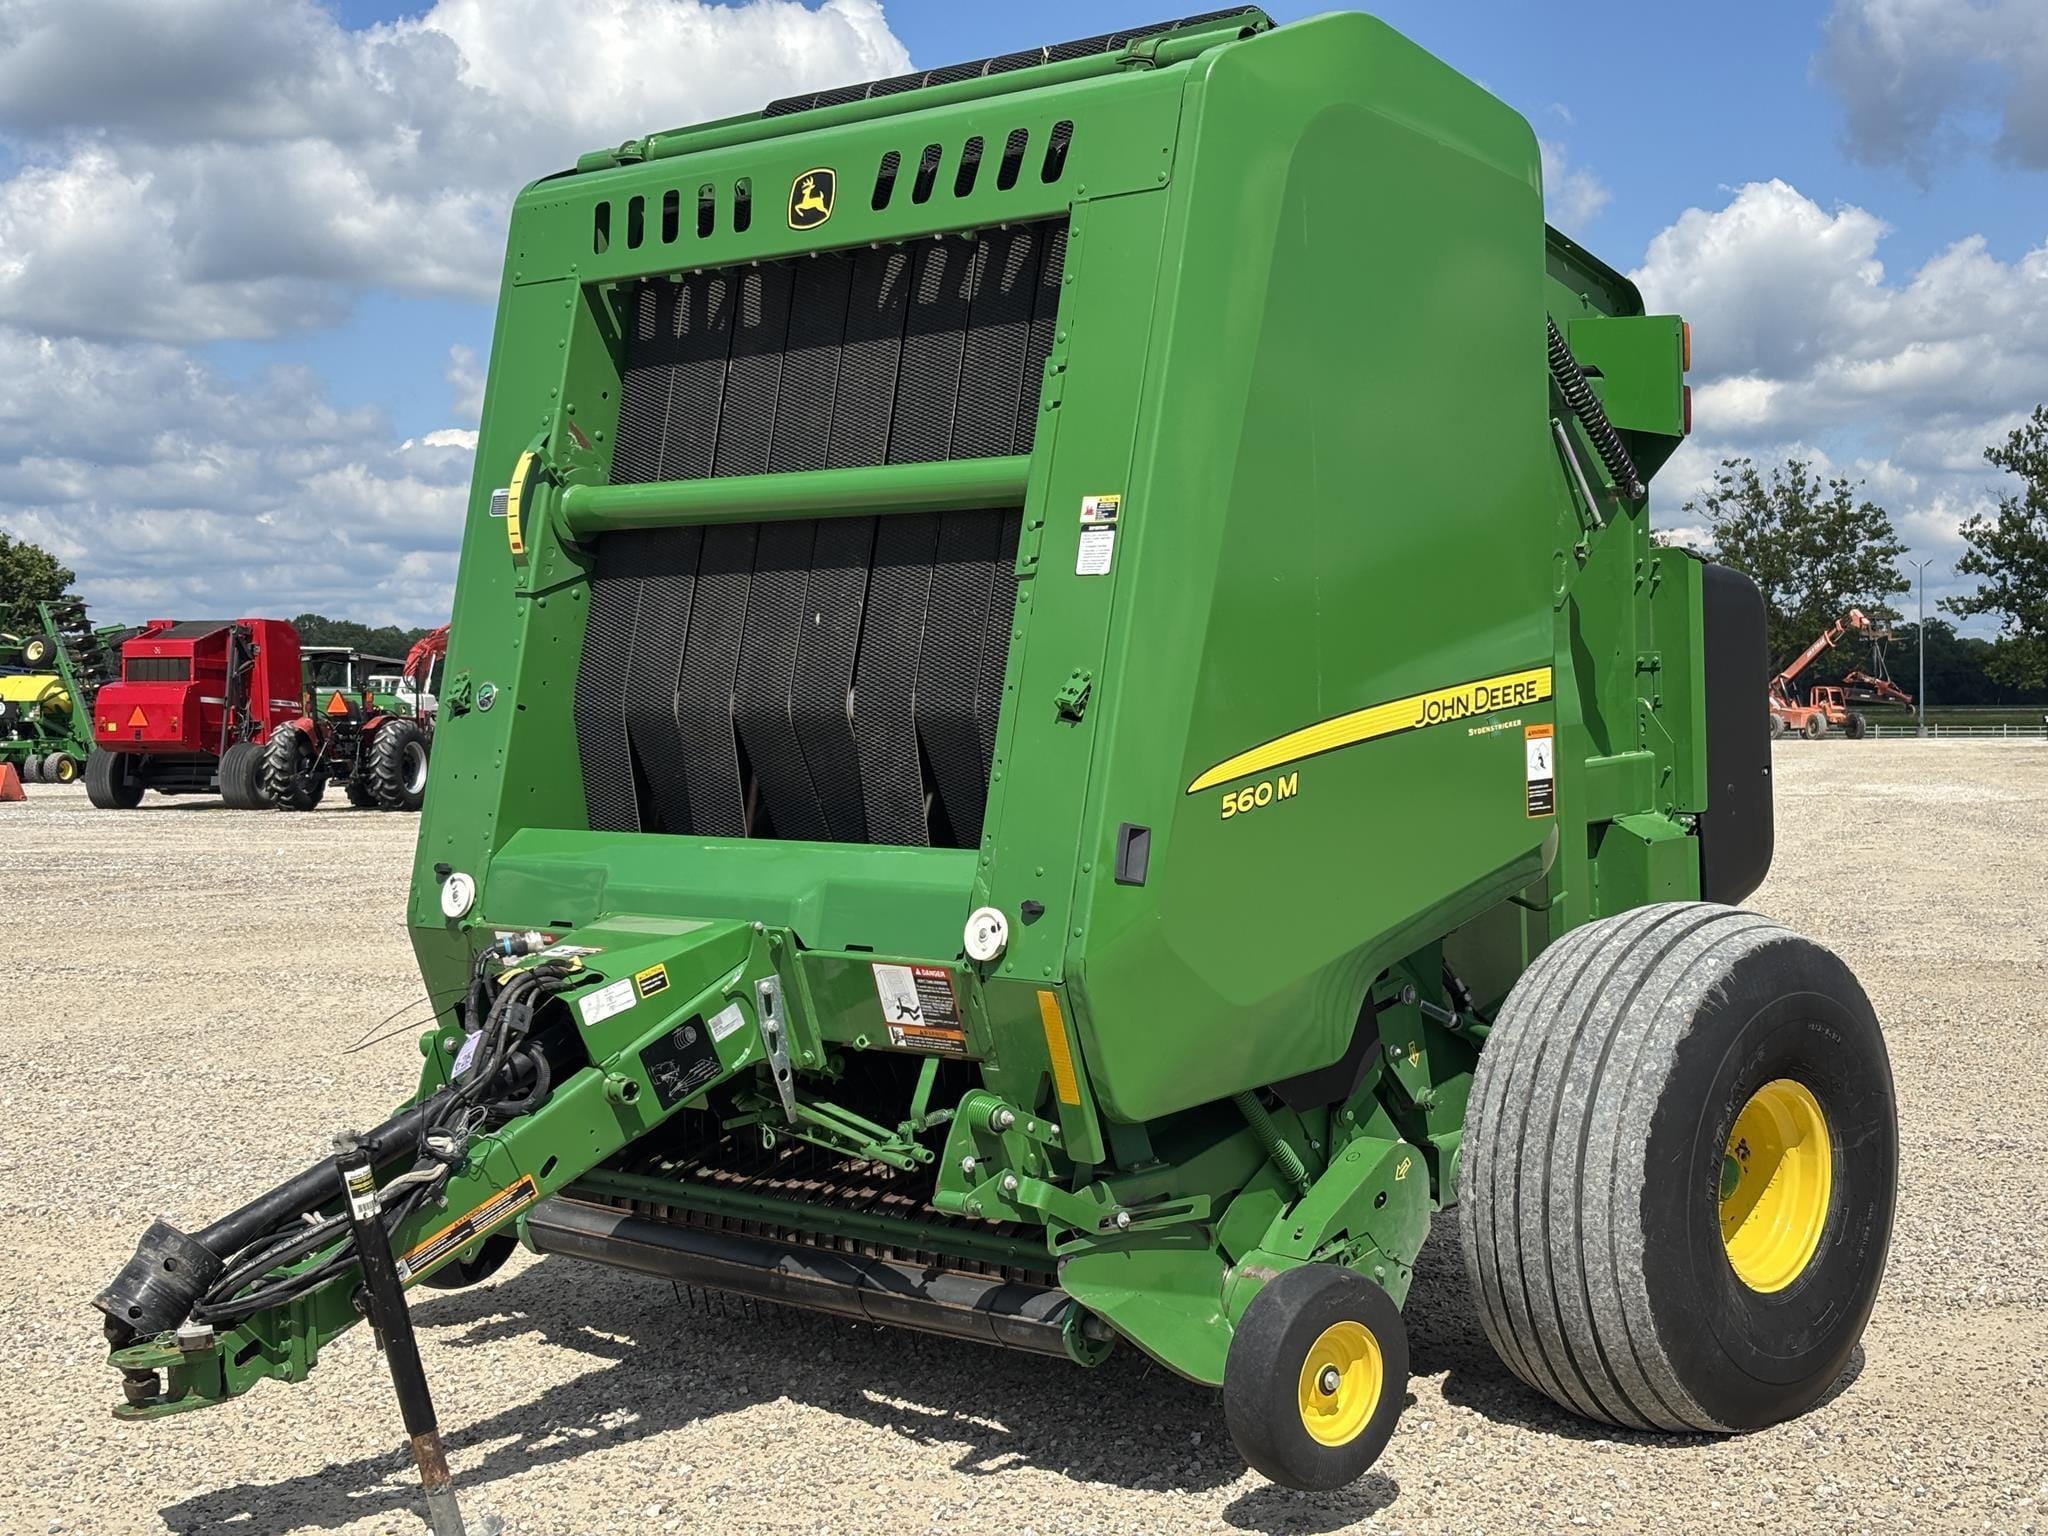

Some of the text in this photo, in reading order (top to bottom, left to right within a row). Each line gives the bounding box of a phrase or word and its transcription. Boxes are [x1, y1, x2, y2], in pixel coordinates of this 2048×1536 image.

[1415, 680, 1537, 725] JOHN DEERE
[1221, 770, 1299, 820] 560 M
